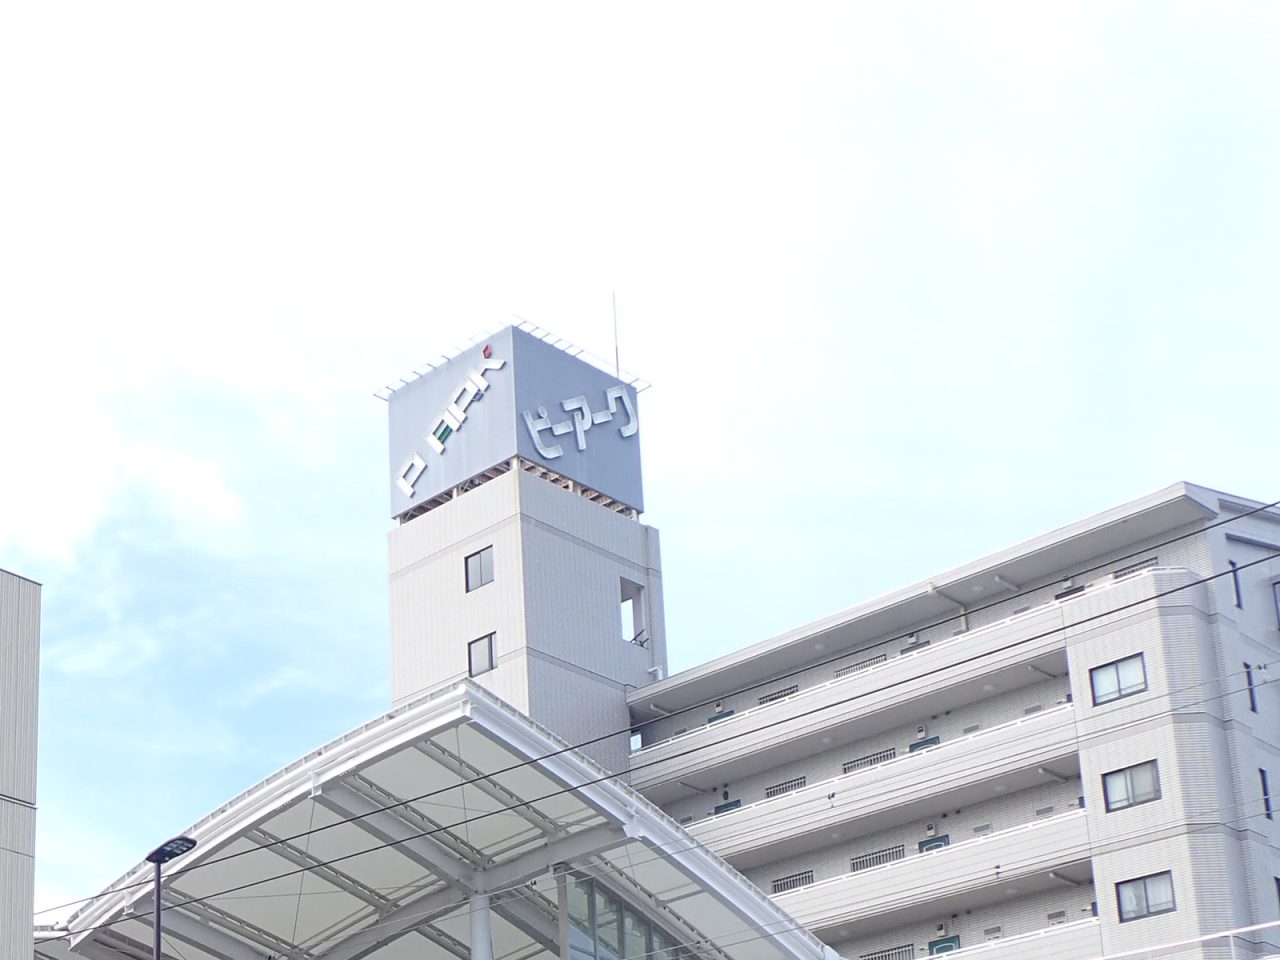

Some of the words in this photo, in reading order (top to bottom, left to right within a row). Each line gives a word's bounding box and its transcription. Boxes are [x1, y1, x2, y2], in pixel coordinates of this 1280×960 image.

[522, 385, 639, 460] ピーアーク
